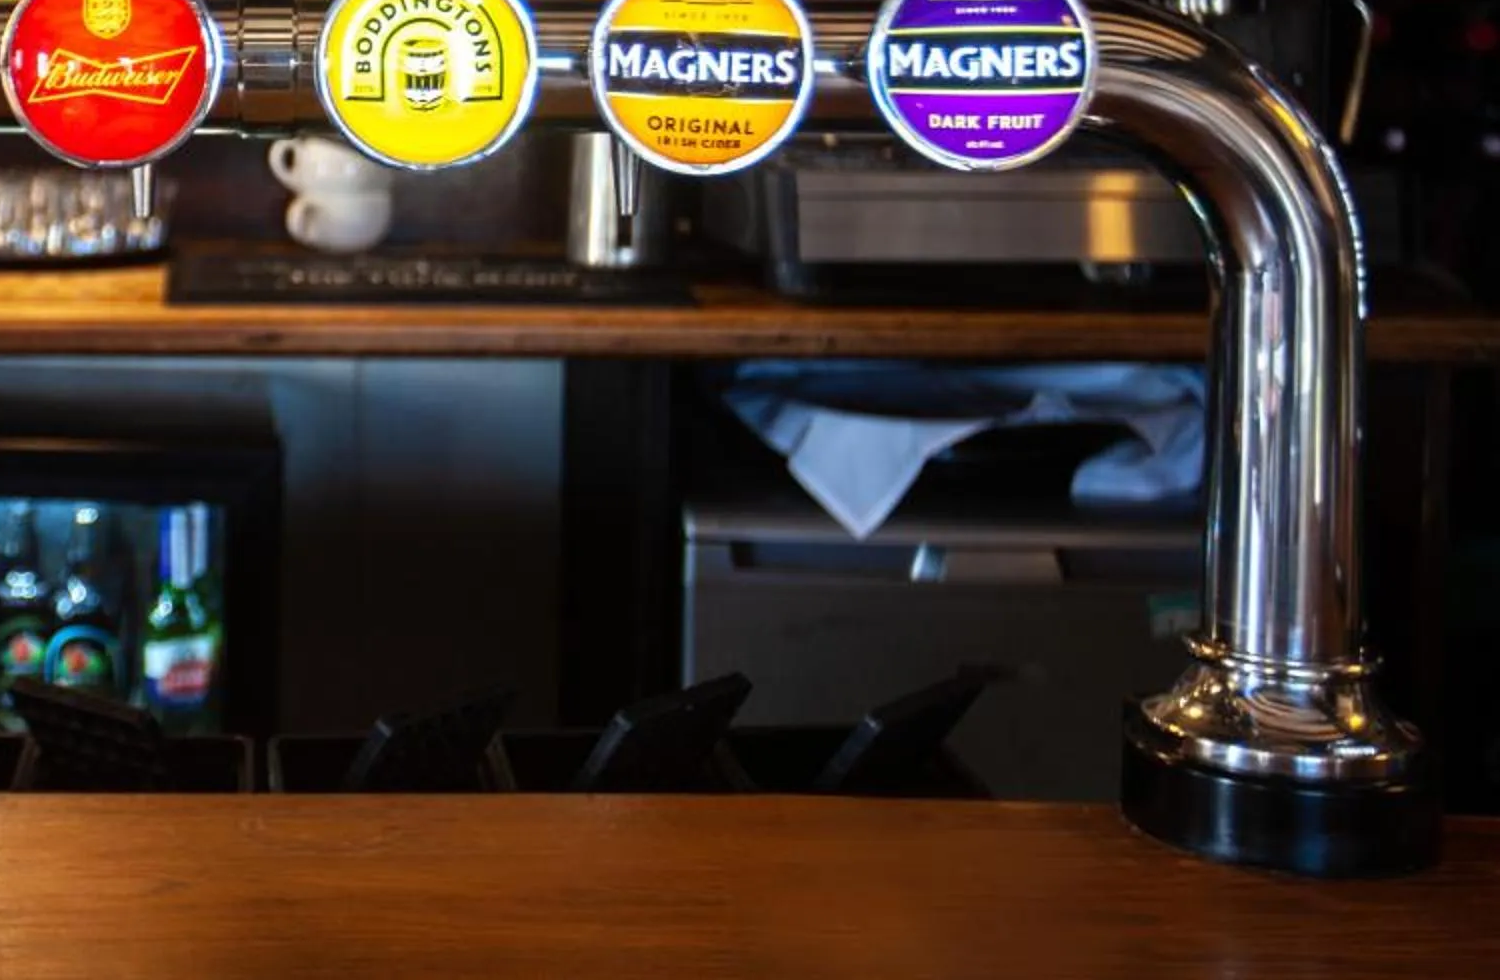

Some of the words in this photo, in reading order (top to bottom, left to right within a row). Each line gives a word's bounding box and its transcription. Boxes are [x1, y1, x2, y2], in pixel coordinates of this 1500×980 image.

[610, 43, 797, 84] MAGNERS
[889, 41, 1078, 81] MAGNERS
[45, 62, 181, 89] Budweiser
[647, 115, 754, 135] ORIGINAL
[928, 114, 980, 129] DARK
[987, 114, 1045, 130] FRUIT
[657, 135, 697, 147] IRISH
